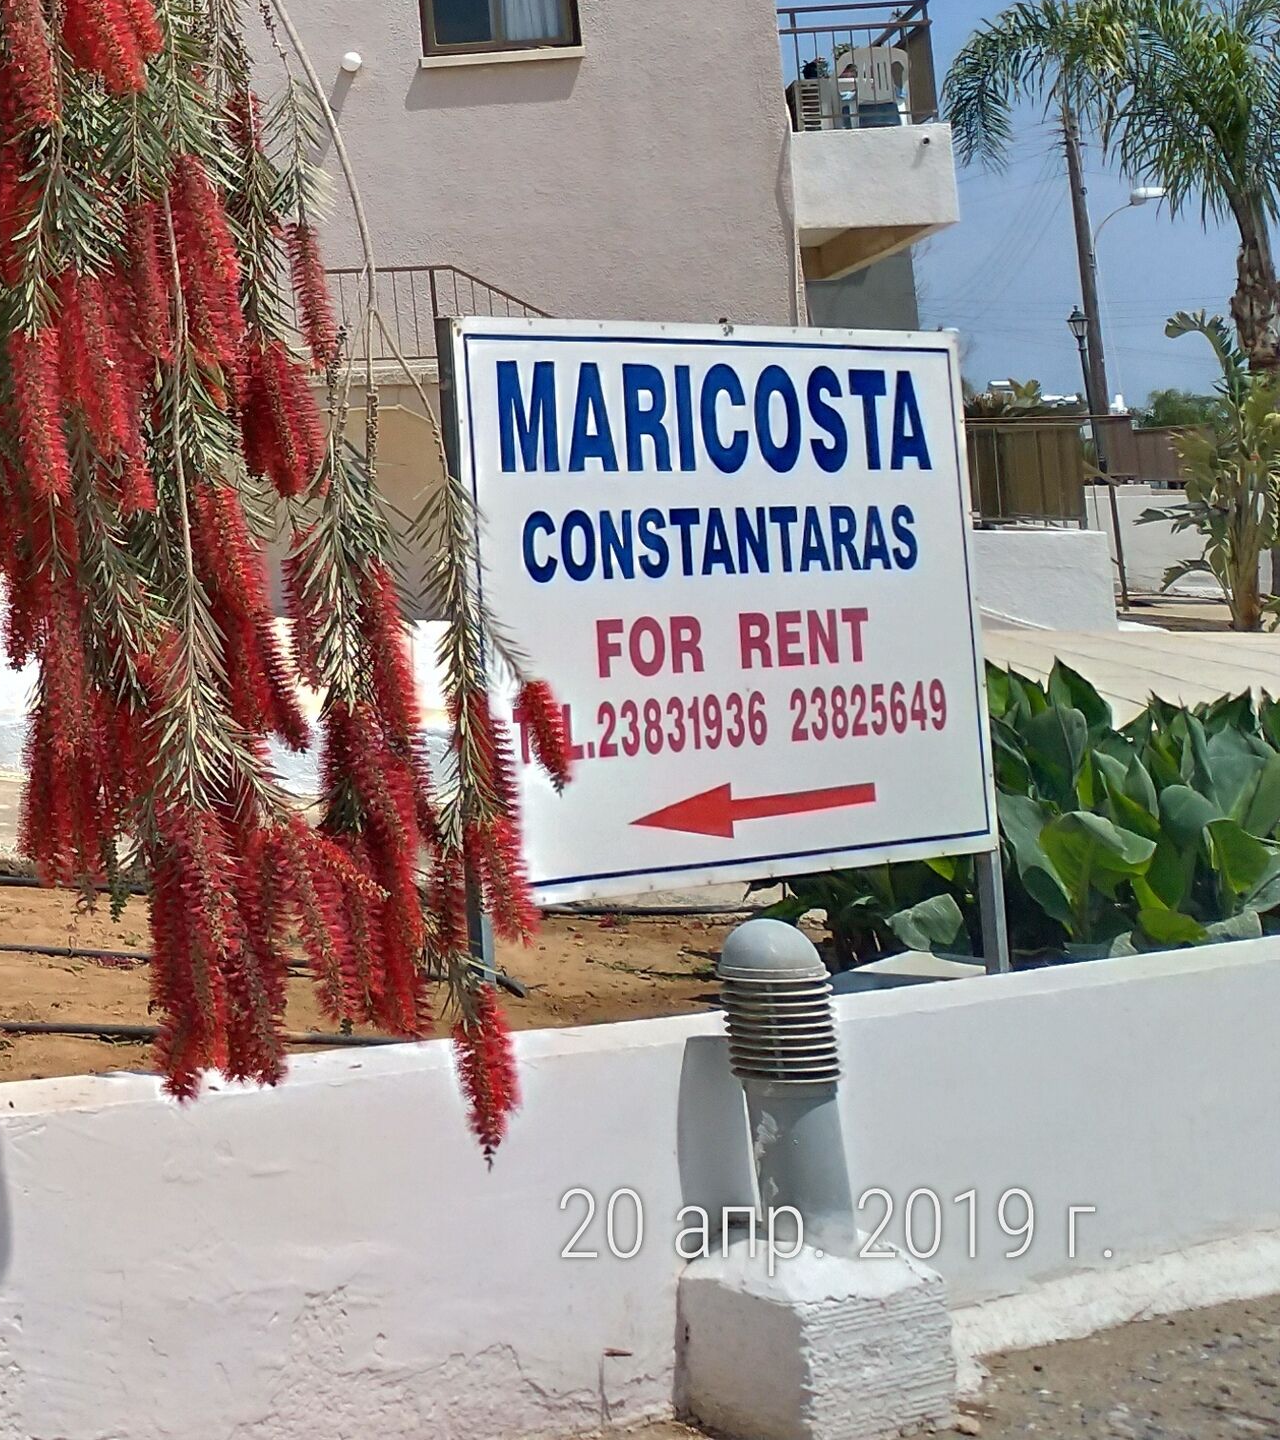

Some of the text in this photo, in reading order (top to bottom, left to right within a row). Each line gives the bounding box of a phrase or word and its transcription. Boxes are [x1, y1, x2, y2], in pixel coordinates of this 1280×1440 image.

[495, 359, 933, 474] MARICOSTA
[522, 503, 919, 583] CONSTANTARAS
[595, 607, 870, 678] FOR RENT
[512, 678, 948, 765] TL.23831936 23825649
